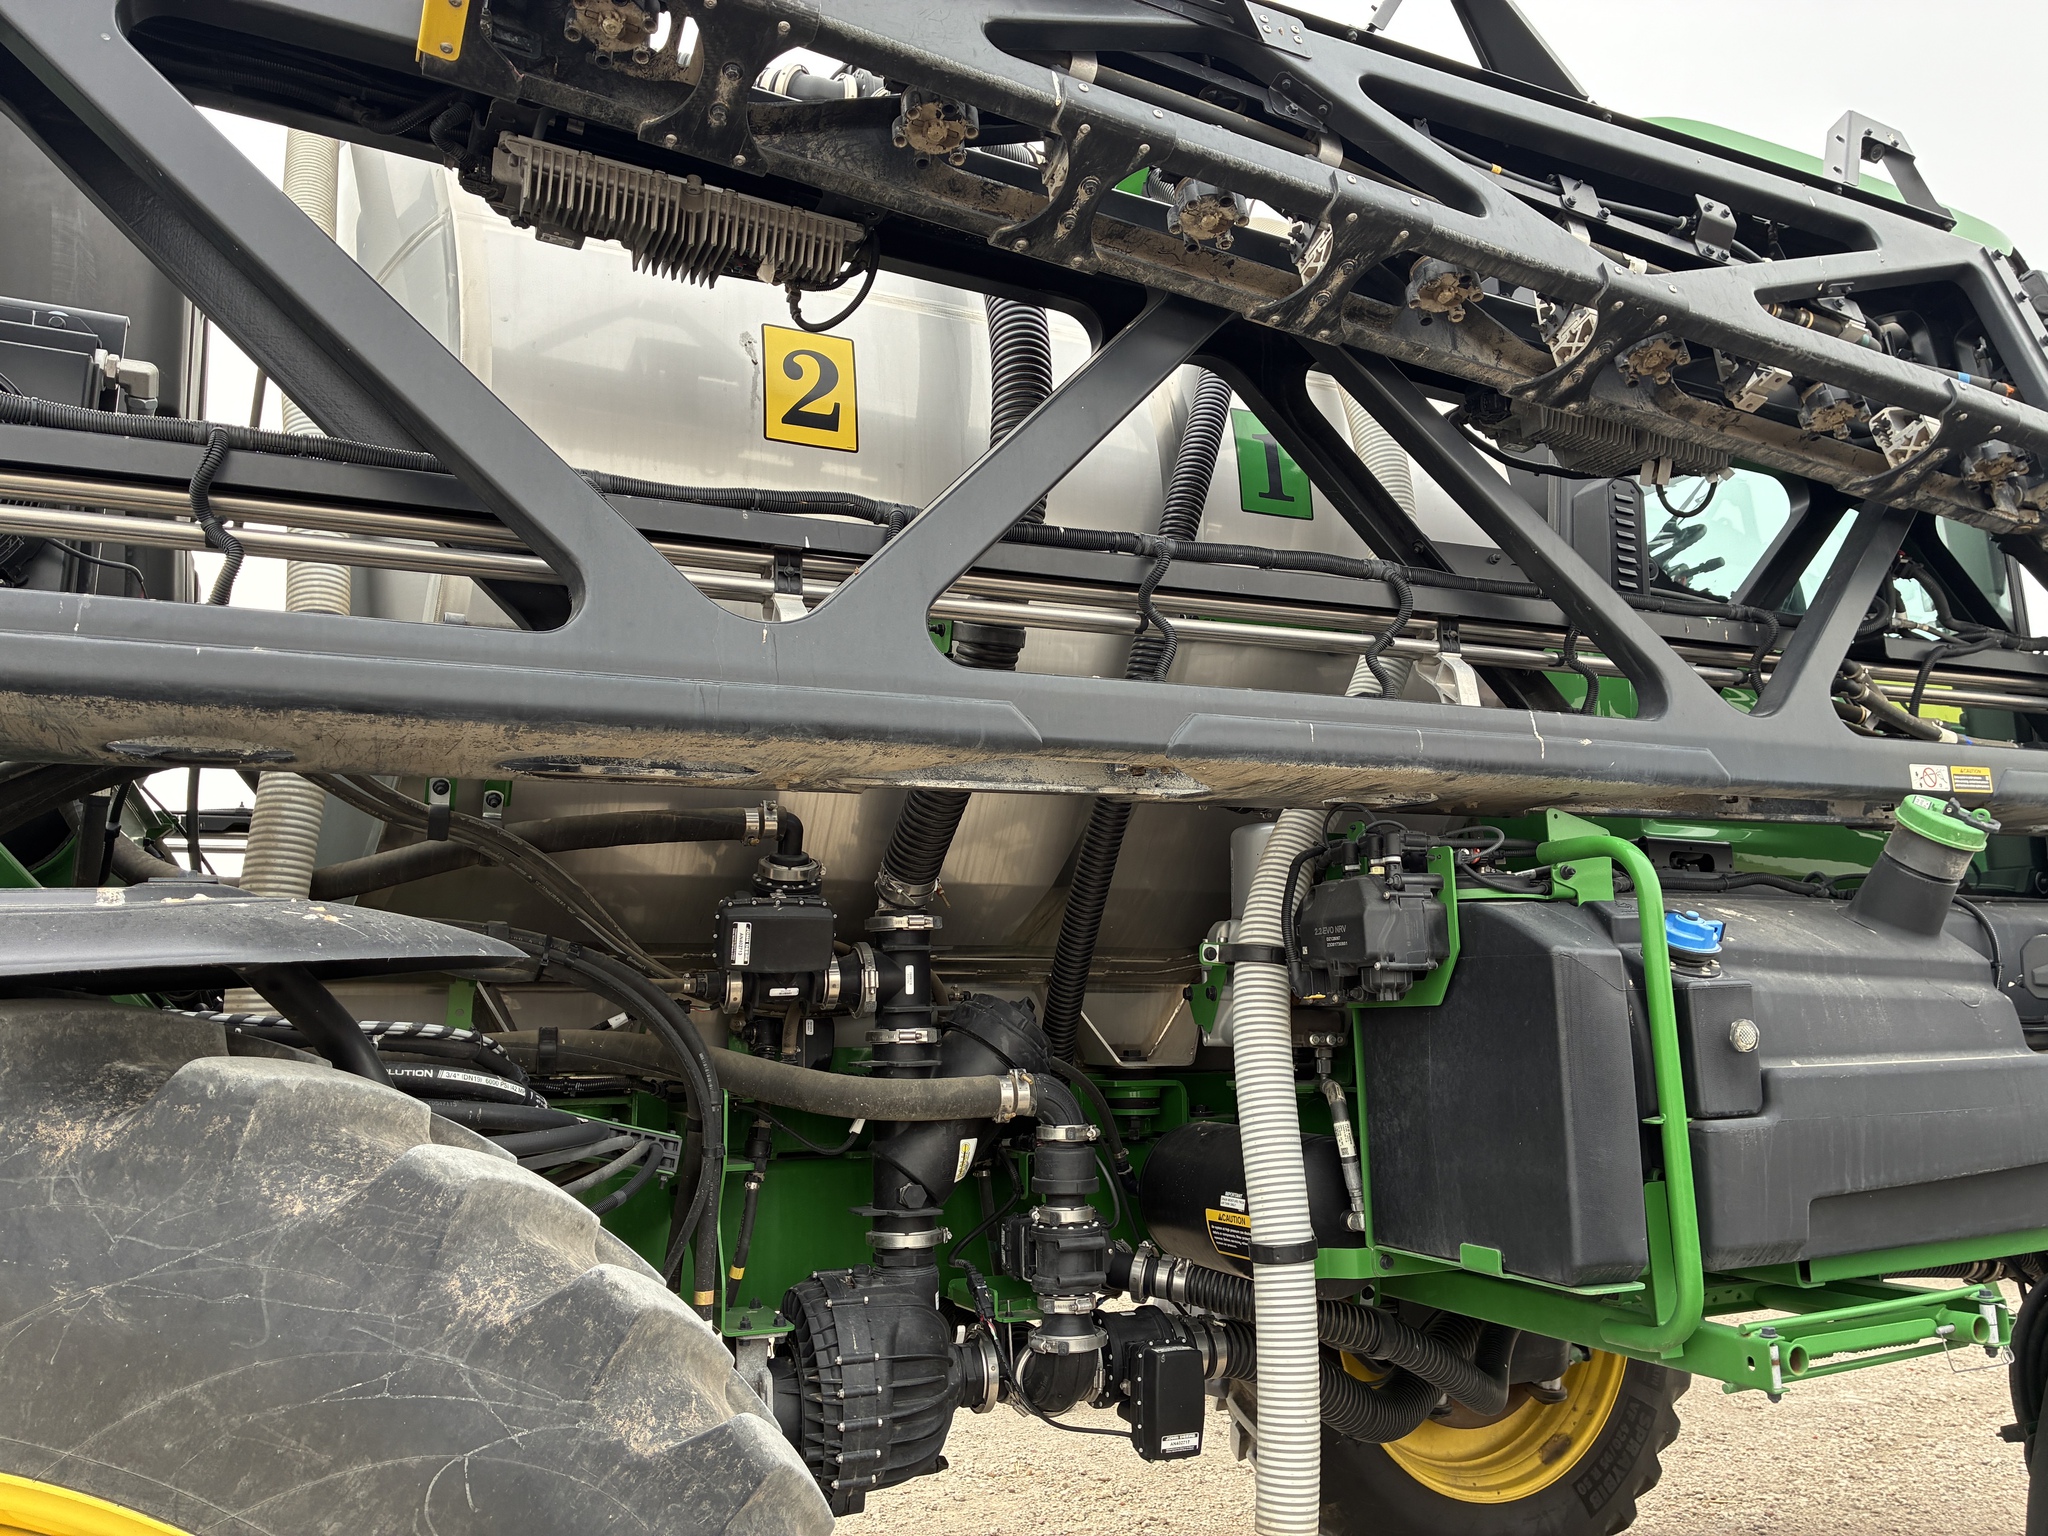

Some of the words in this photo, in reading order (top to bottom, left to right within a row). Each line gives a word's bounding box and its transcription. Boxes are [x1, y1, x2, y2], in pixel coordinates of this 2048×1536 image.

[782, 349, 840, 432] 2
[1252, 432, 1295, 502] 1
[1335, 925, 1347, 933] NRV
[386, 1069, 434, 1079] LUTION
[485, 1078, 500, 1087] 6000
[1221, 1214, 1246, 1225] CAUTION
[1588, 1412, 1651, 1510] SPRAYBIB
